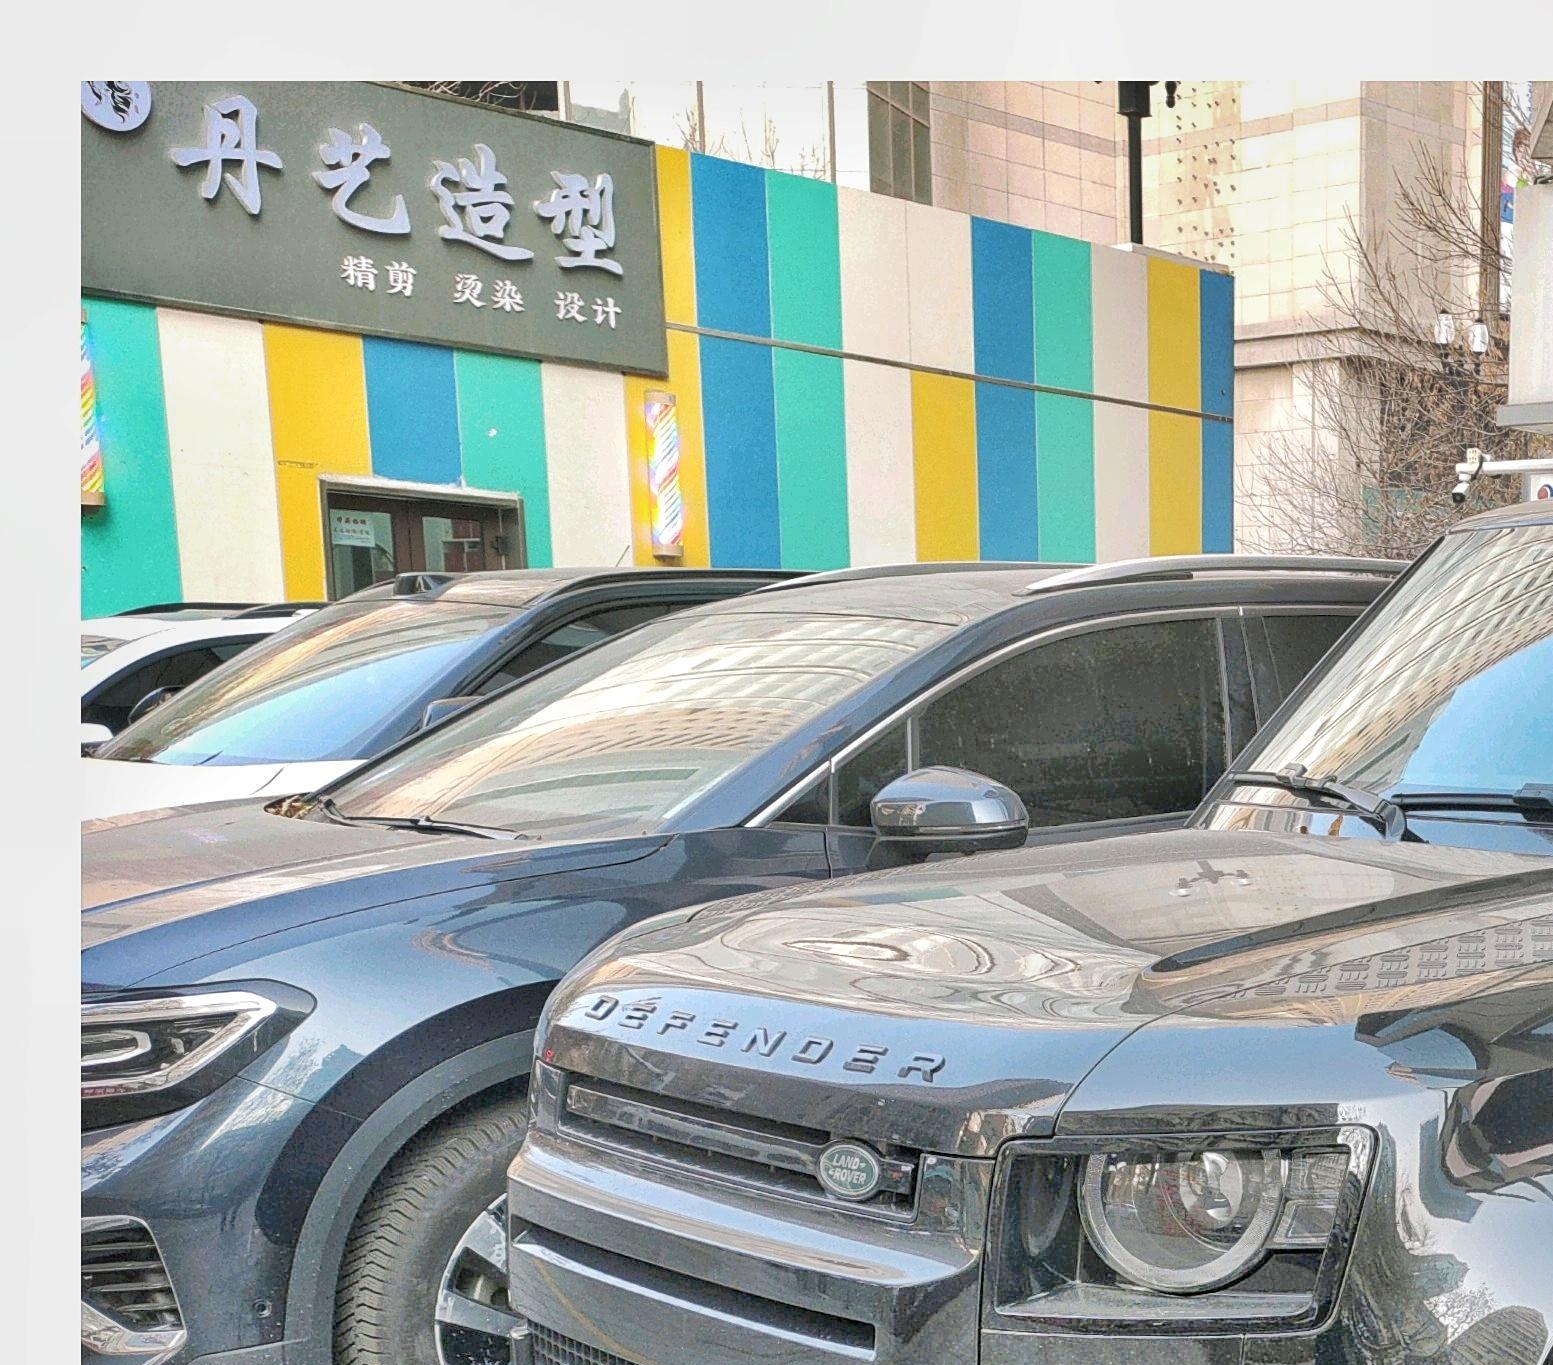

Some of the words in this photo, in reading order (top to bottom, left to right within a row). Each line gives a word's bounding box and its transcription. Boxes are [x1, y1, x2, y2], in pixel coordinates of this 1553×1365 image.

[171, 95, 624, 276] 丹艺造型
[340, 255, 417, 297] 精剪
[453, 273, 526, 313] 烫染
[553, 291, 623, 329] 设计
[584, 994, 945, 1083] DEFENDER
[832, 1153, 860, 1170] LAND
[832, 1168, 867, 1185] ROVER
